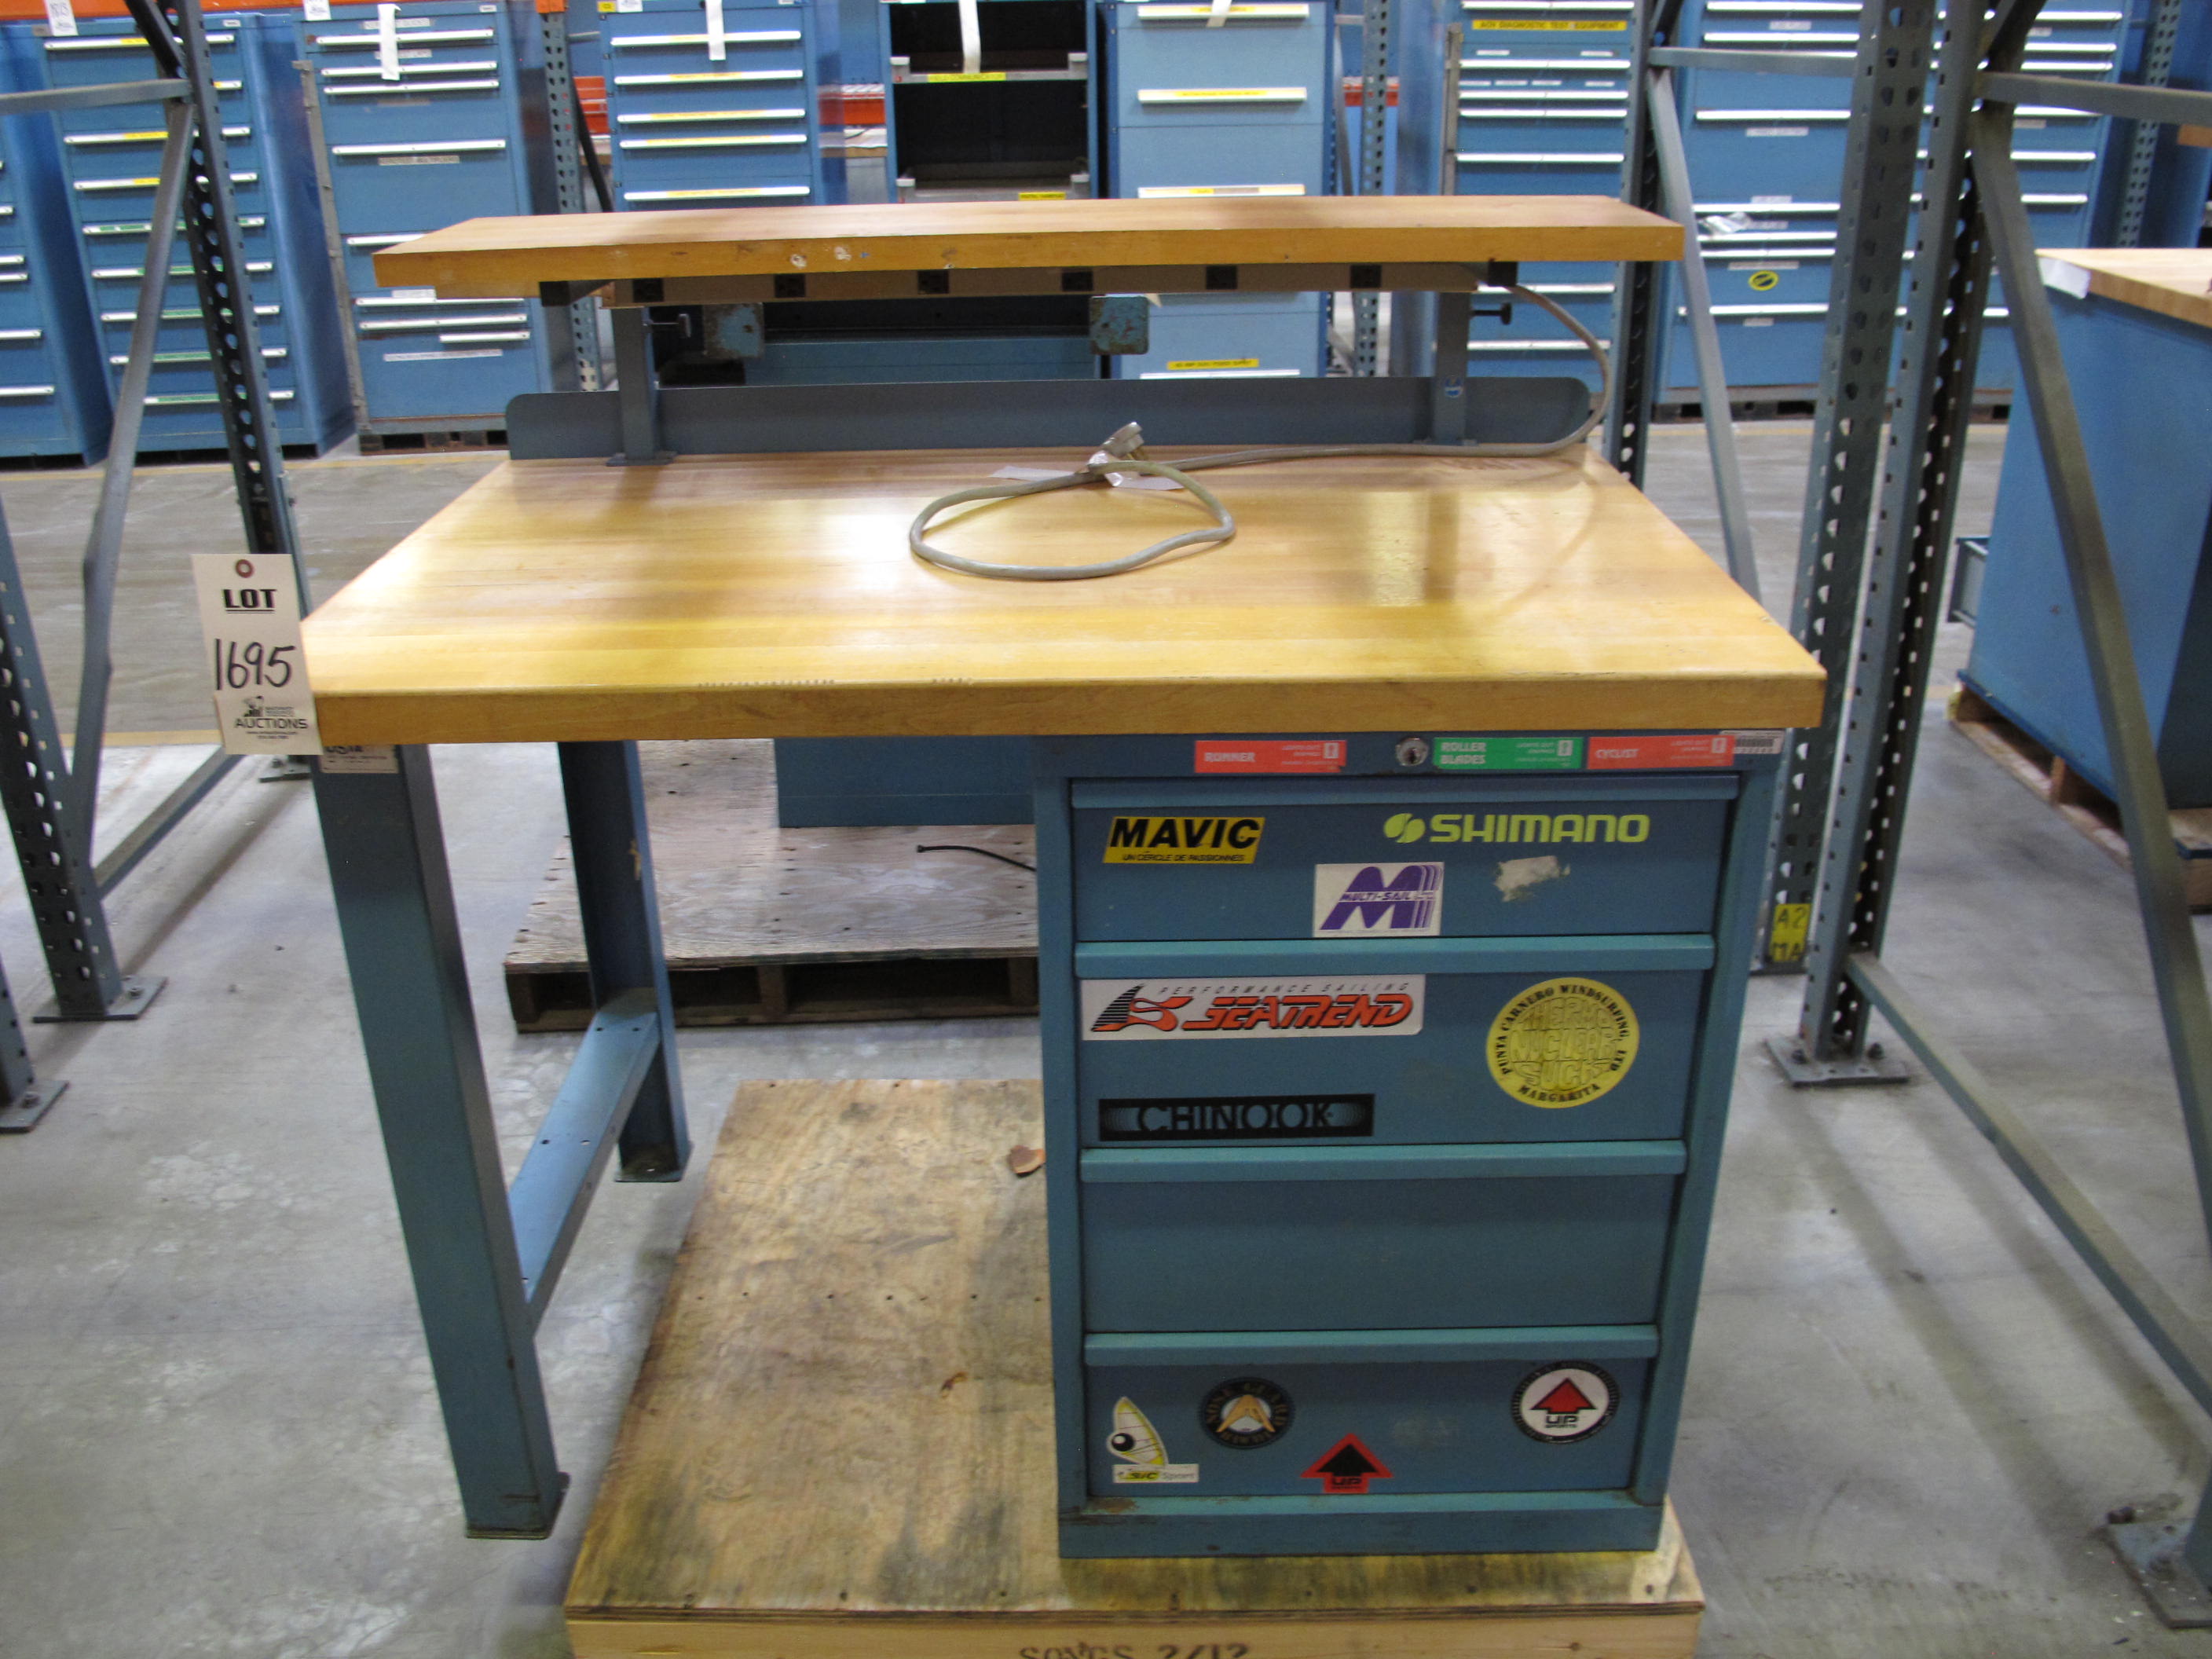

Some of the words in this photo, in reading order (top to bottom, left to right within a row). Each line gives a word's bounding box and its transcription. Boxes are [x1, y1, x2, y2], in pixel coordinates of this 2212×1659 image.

[223, 589, 276, 609] LOT
[214, 638, 296, 690] 1695
[234, 718, 309, 729] AUCTIONS
[1440, 742, 1488, 753] ROLLER
[1595, 748, 1640, 760] CYCLIST
[1440, 754, 1486, 765] BLADES
[1110, 818, 1260, 849] MAVIC
[1429, 813, 1650, 844] SHIMANO
[1158, 983, 1311, 995] PERFORMANCE
[1320, 982, 1410, 994] SAILING
[1181, 993, 1414, 1031] SEATREND
[1501, 987, 1555, 1031] CARNERO
[1559, 984, 1630, 1038] WINDSURFING
[1496, 1035, 1514, 1075] PUNTA
[1518, 1083, 1601, 1102] MARGARITA
[1137, 1102, 1335, 1132] CHINOOK
[1545, 1415, 1579, 1424] UP
[1331, 1477, 1362, 1486] UP
